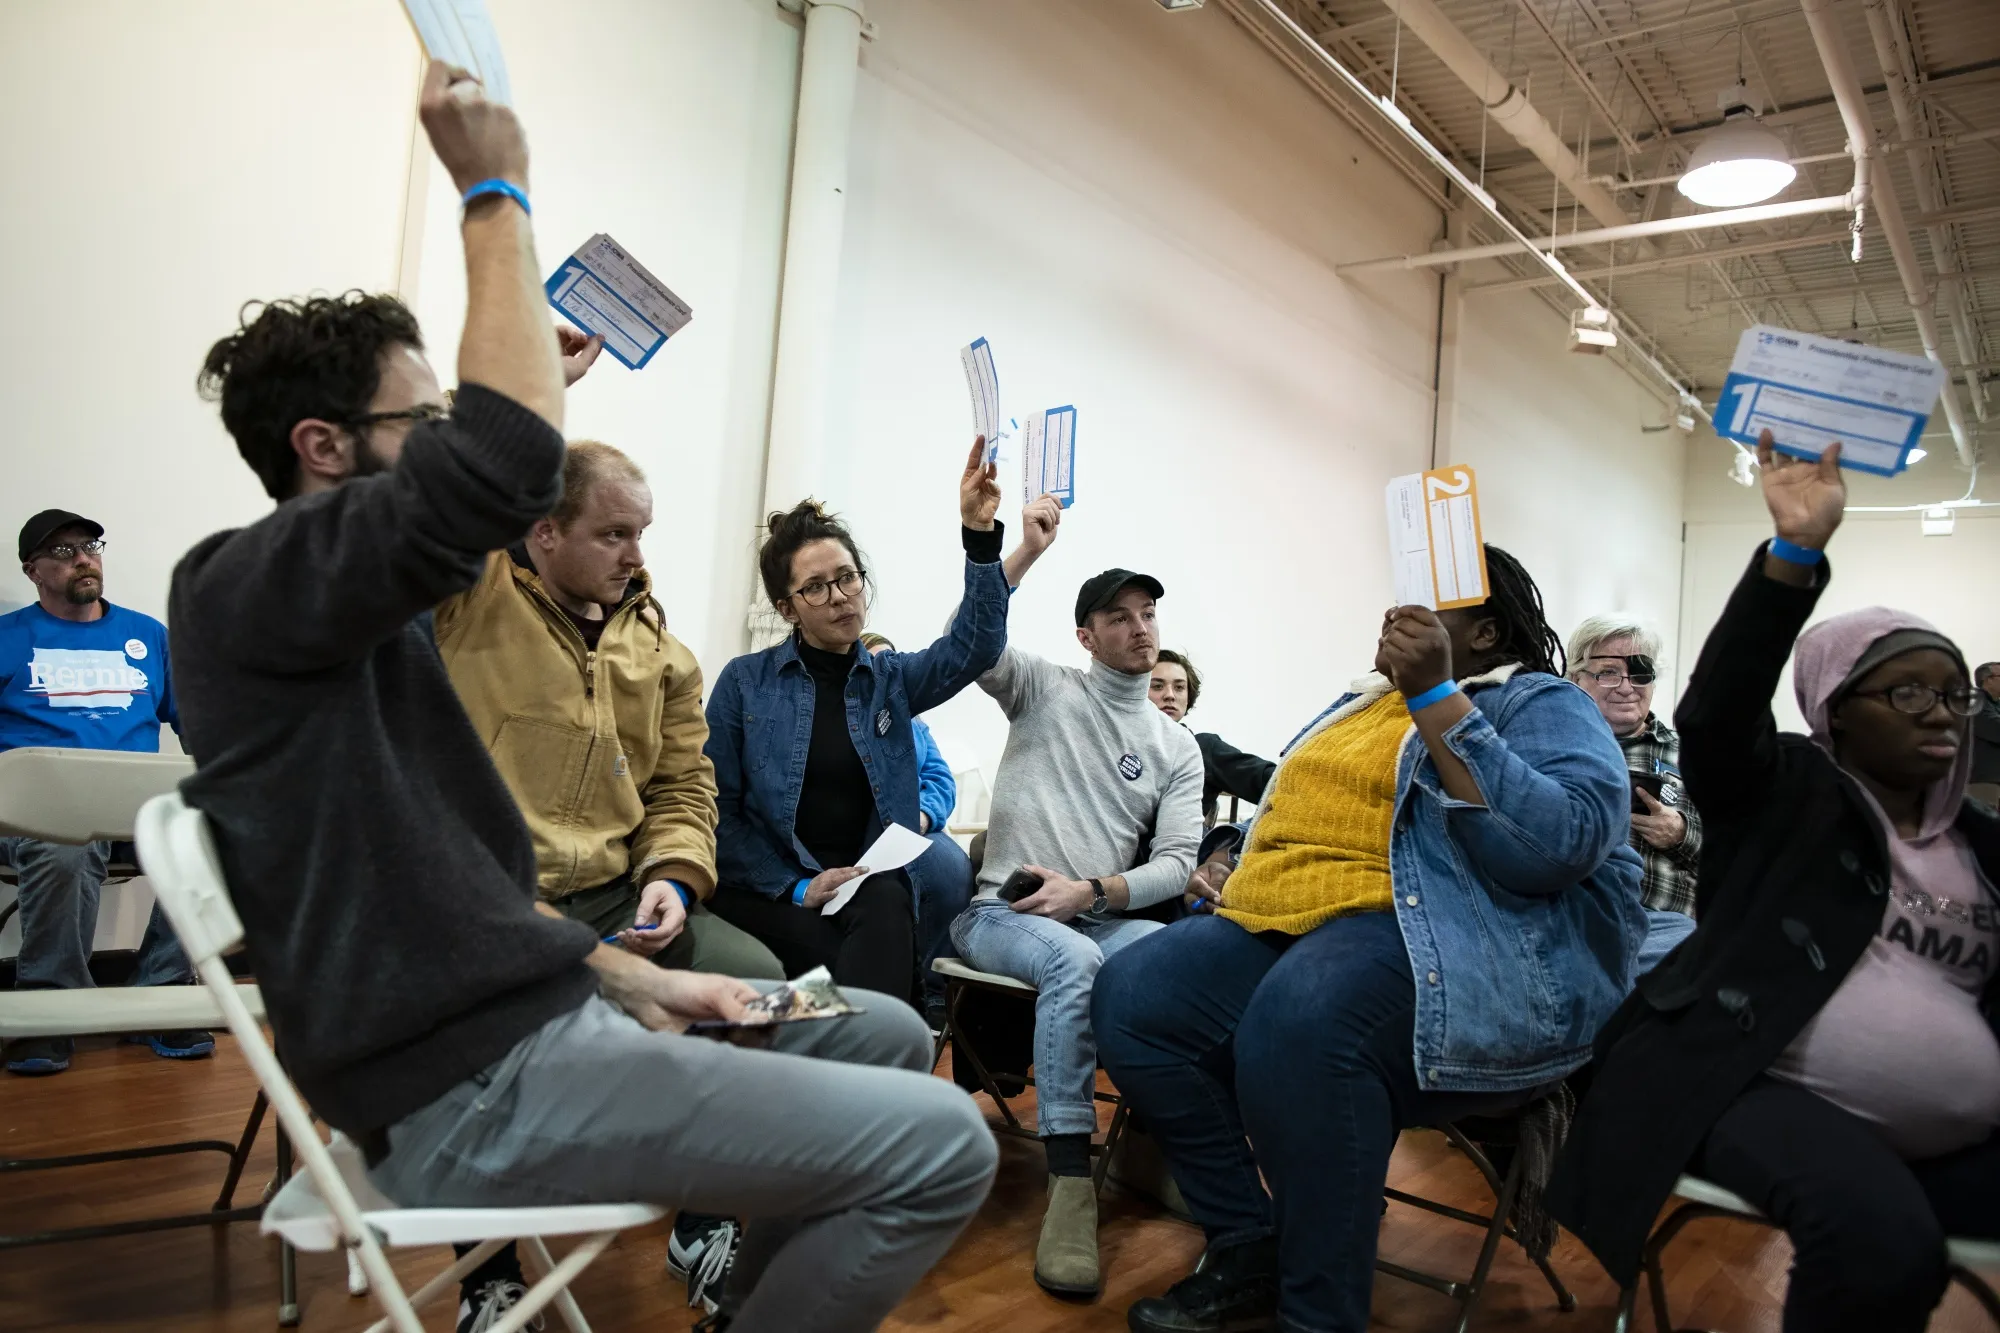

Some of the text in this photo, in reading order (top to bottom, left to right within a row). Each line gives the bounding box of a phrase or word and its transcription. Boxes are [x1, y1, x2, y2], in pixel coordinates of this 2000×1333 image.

[552, 265, 587, 303] 1
[626, 262, 653, 288] Presidential
[652, 284, 677, 308] Preference
[675, 303, 688, 317] Card
[1730, 382, 1760, 434] 1
[1426, 470, 1471, 501] 2
[28, 660, 142, 690] Bernie
[1119, 765, 1137, 778] TRUMP
[1122, 760, 1136, 773] BEATS
[1886, 915, 1989, 976] AMA
